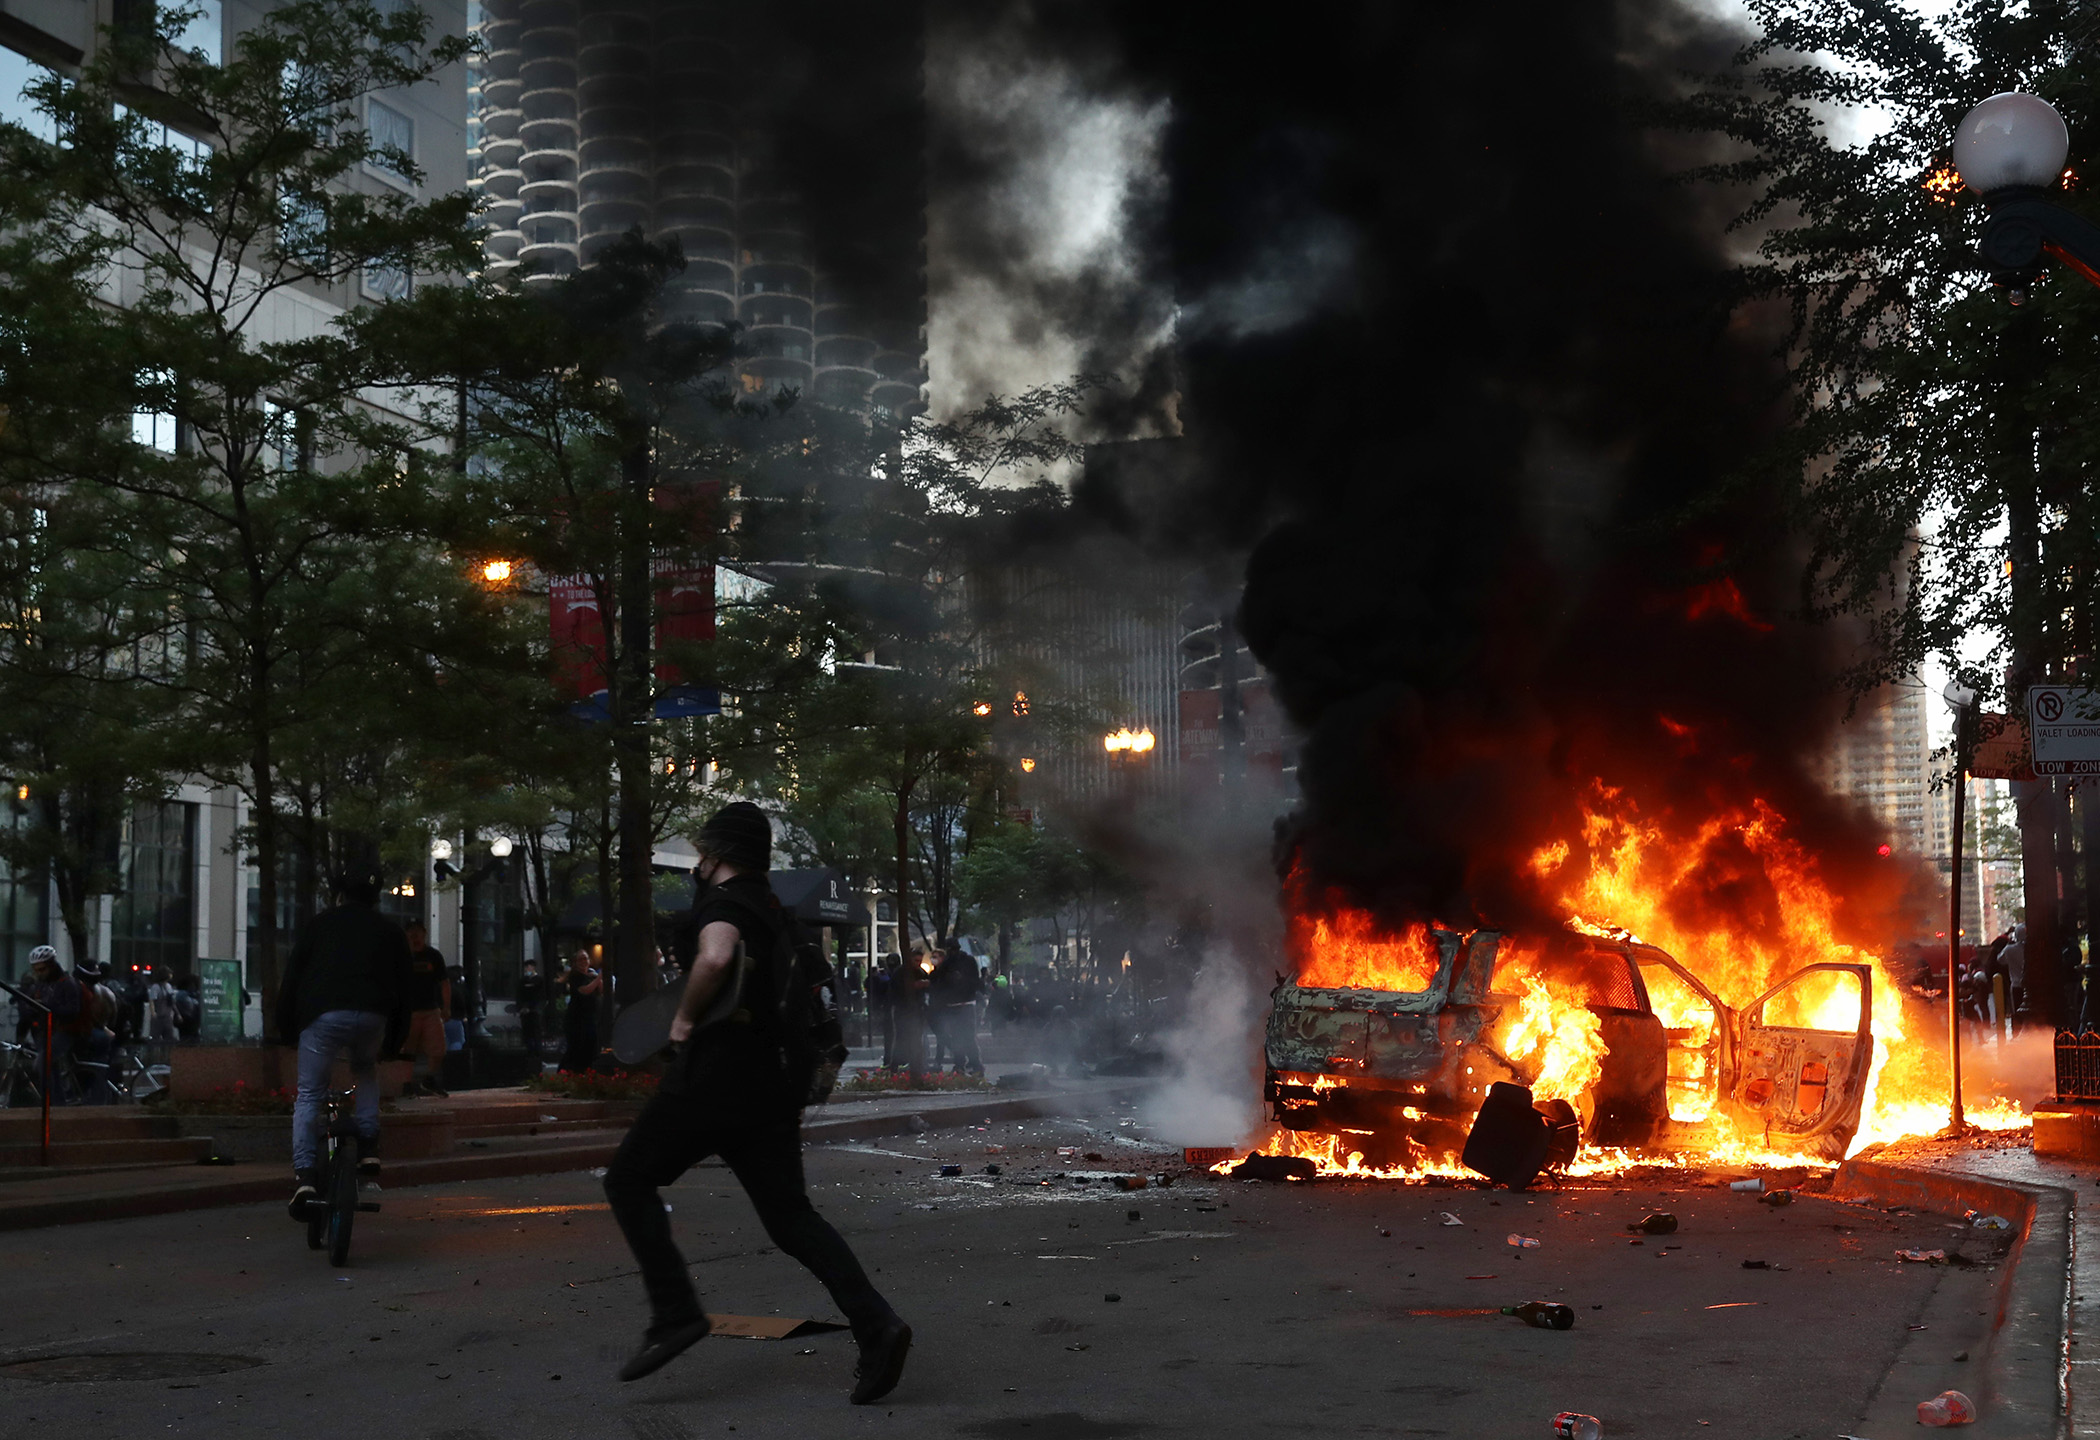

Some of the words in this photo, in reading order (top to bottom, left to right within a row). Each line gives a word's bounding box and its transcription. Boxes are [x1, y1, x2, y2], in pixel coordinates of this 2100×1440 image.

[2037, 729, 2062, 738] VALET
[2039, 761, 2065, 773] TOW
[2072, 761, 2100, 773] ZON
[830, 880, 838, 899] R
